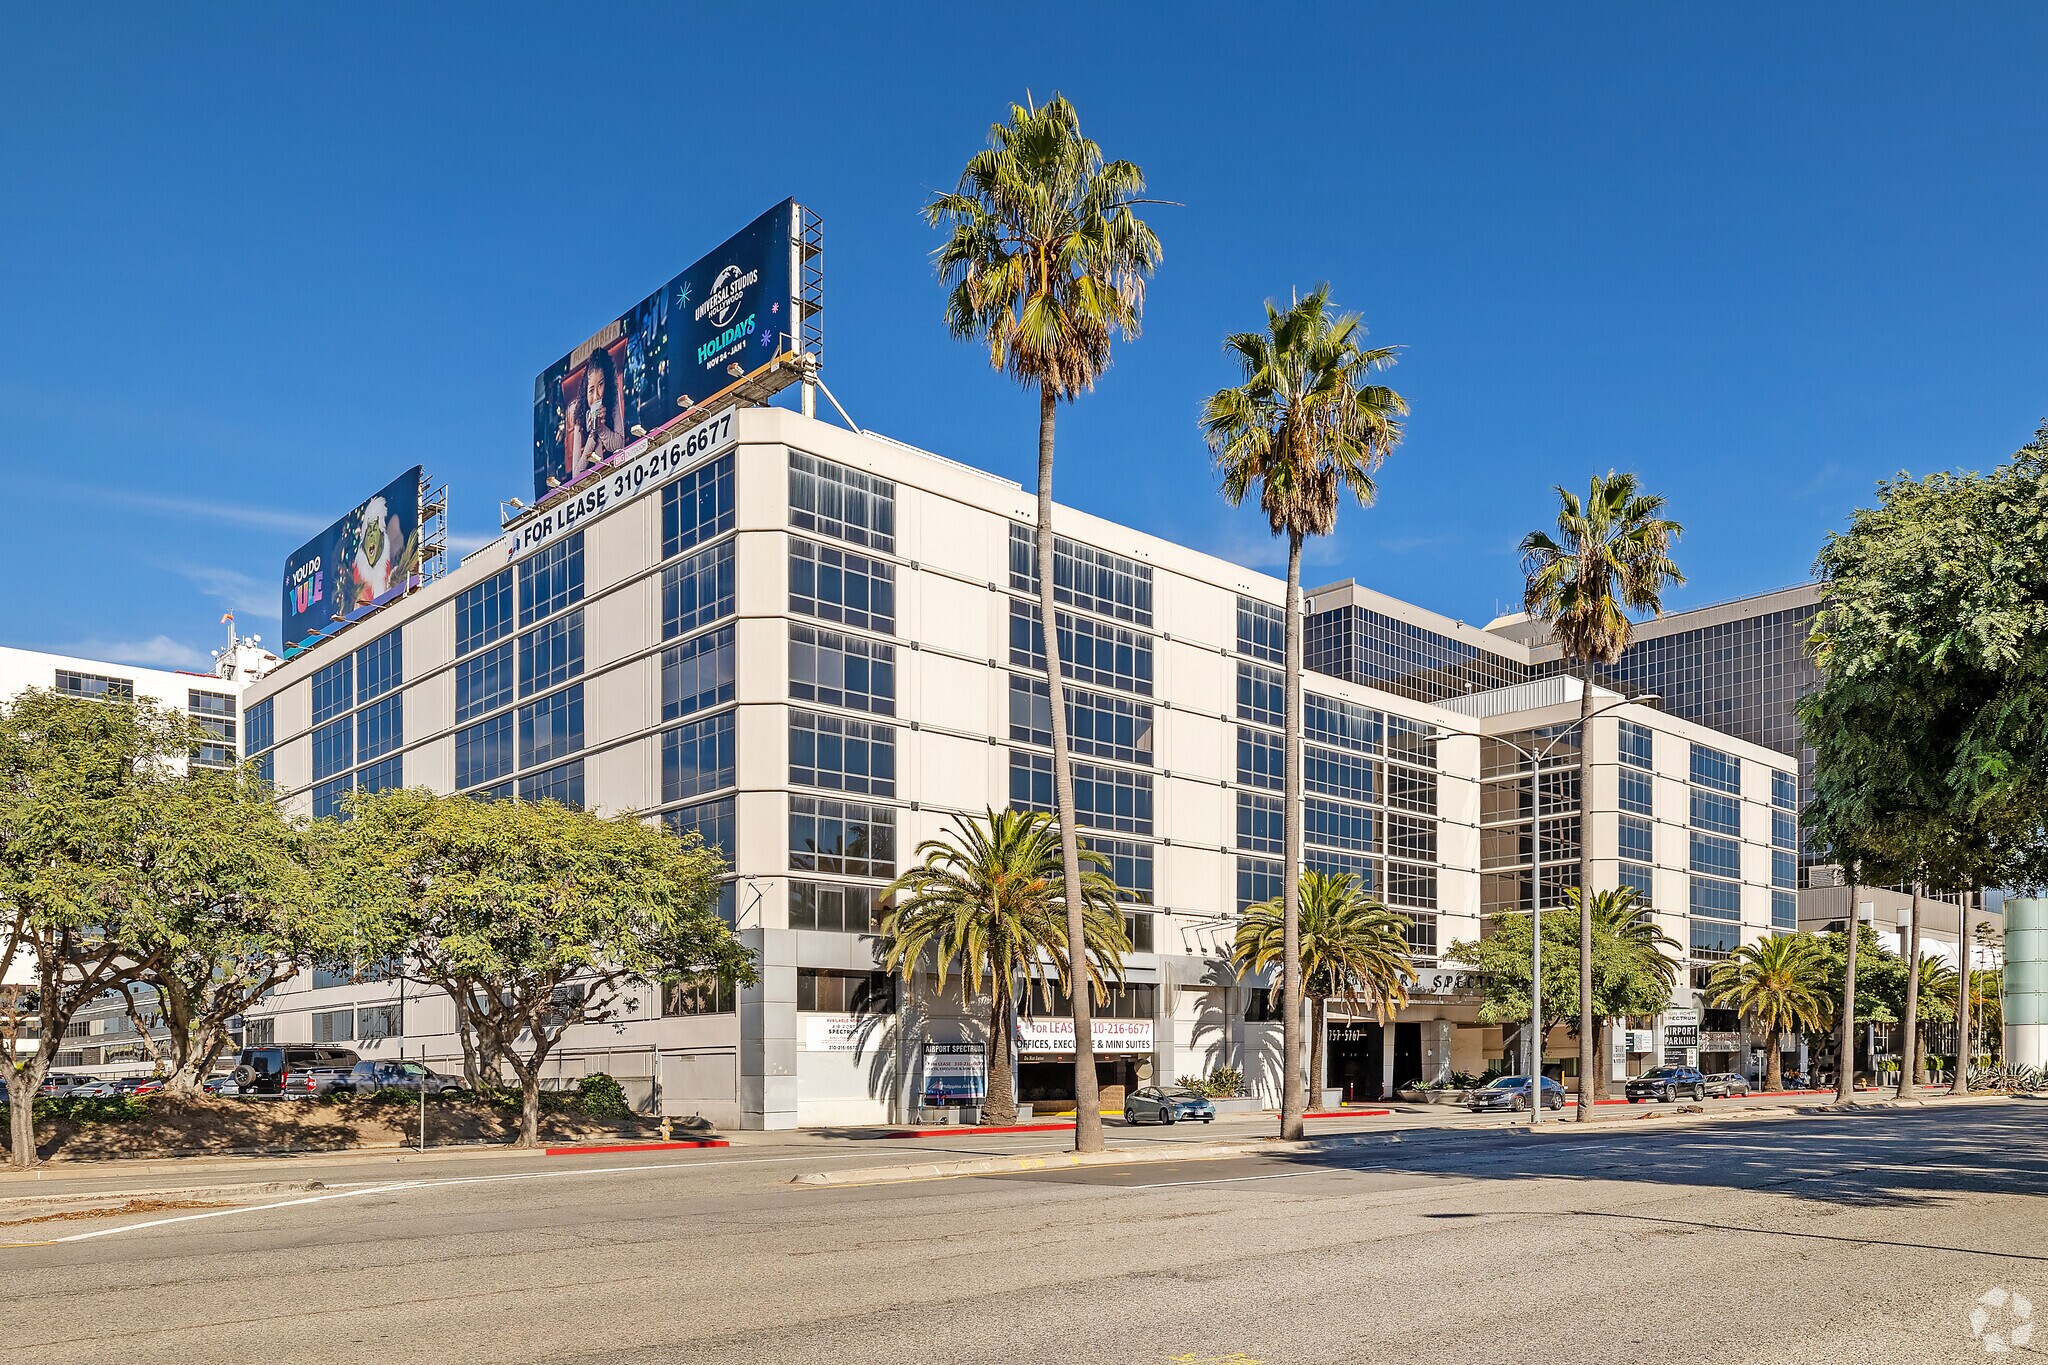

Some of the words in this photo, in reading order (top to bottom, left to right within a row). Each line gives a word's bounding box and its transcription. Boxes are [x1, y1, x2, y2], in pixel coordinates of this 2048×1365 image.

[695, 286, 729, 321] UNIVERSAL
[730, 269, 758, 296] STUDIOS
[709, 291, 744, 319] HOLLYWOOD
[698, 313, 755, 364] HOLIDAYS
[706, 357, 720, 370] NOV
[730, 342, 742, 355] JAN
[524, 519, 552, 548] FOR
[557, 484, 607, 528] LEASE
[614, 413, 731, 498] 310-216-6677
[293, 563, 308, 586] YOU
[309, 556, 320, 576] DO
[290, 571, 323, 617] YULE
[1433, 974, 1496, 988] SPECTR
[1031, 1024, 1047, 1034] FOR
[1049, 1022, 1075, 1034] LEAS
[1090, 1023, 1150, 1034] 10-216-6677
[1664, 1026, 1697, 1036] AIRPORT
[1664, 1036, 1697, 1046] PARKING
[925, 1045, 951, 1053] AIRPORT
[952, 1045, 984, 1053] SPECTRUM
[1016, 1039, 1052, 1050] OFFICES,
[1053, 1039, 1095, 1049] EXECUE
[1097, 1040, 1104, 1049] &
[1105, 1040, 1123, 1049] MINI
[1125, 1040, 1150, 1049] SUITES
